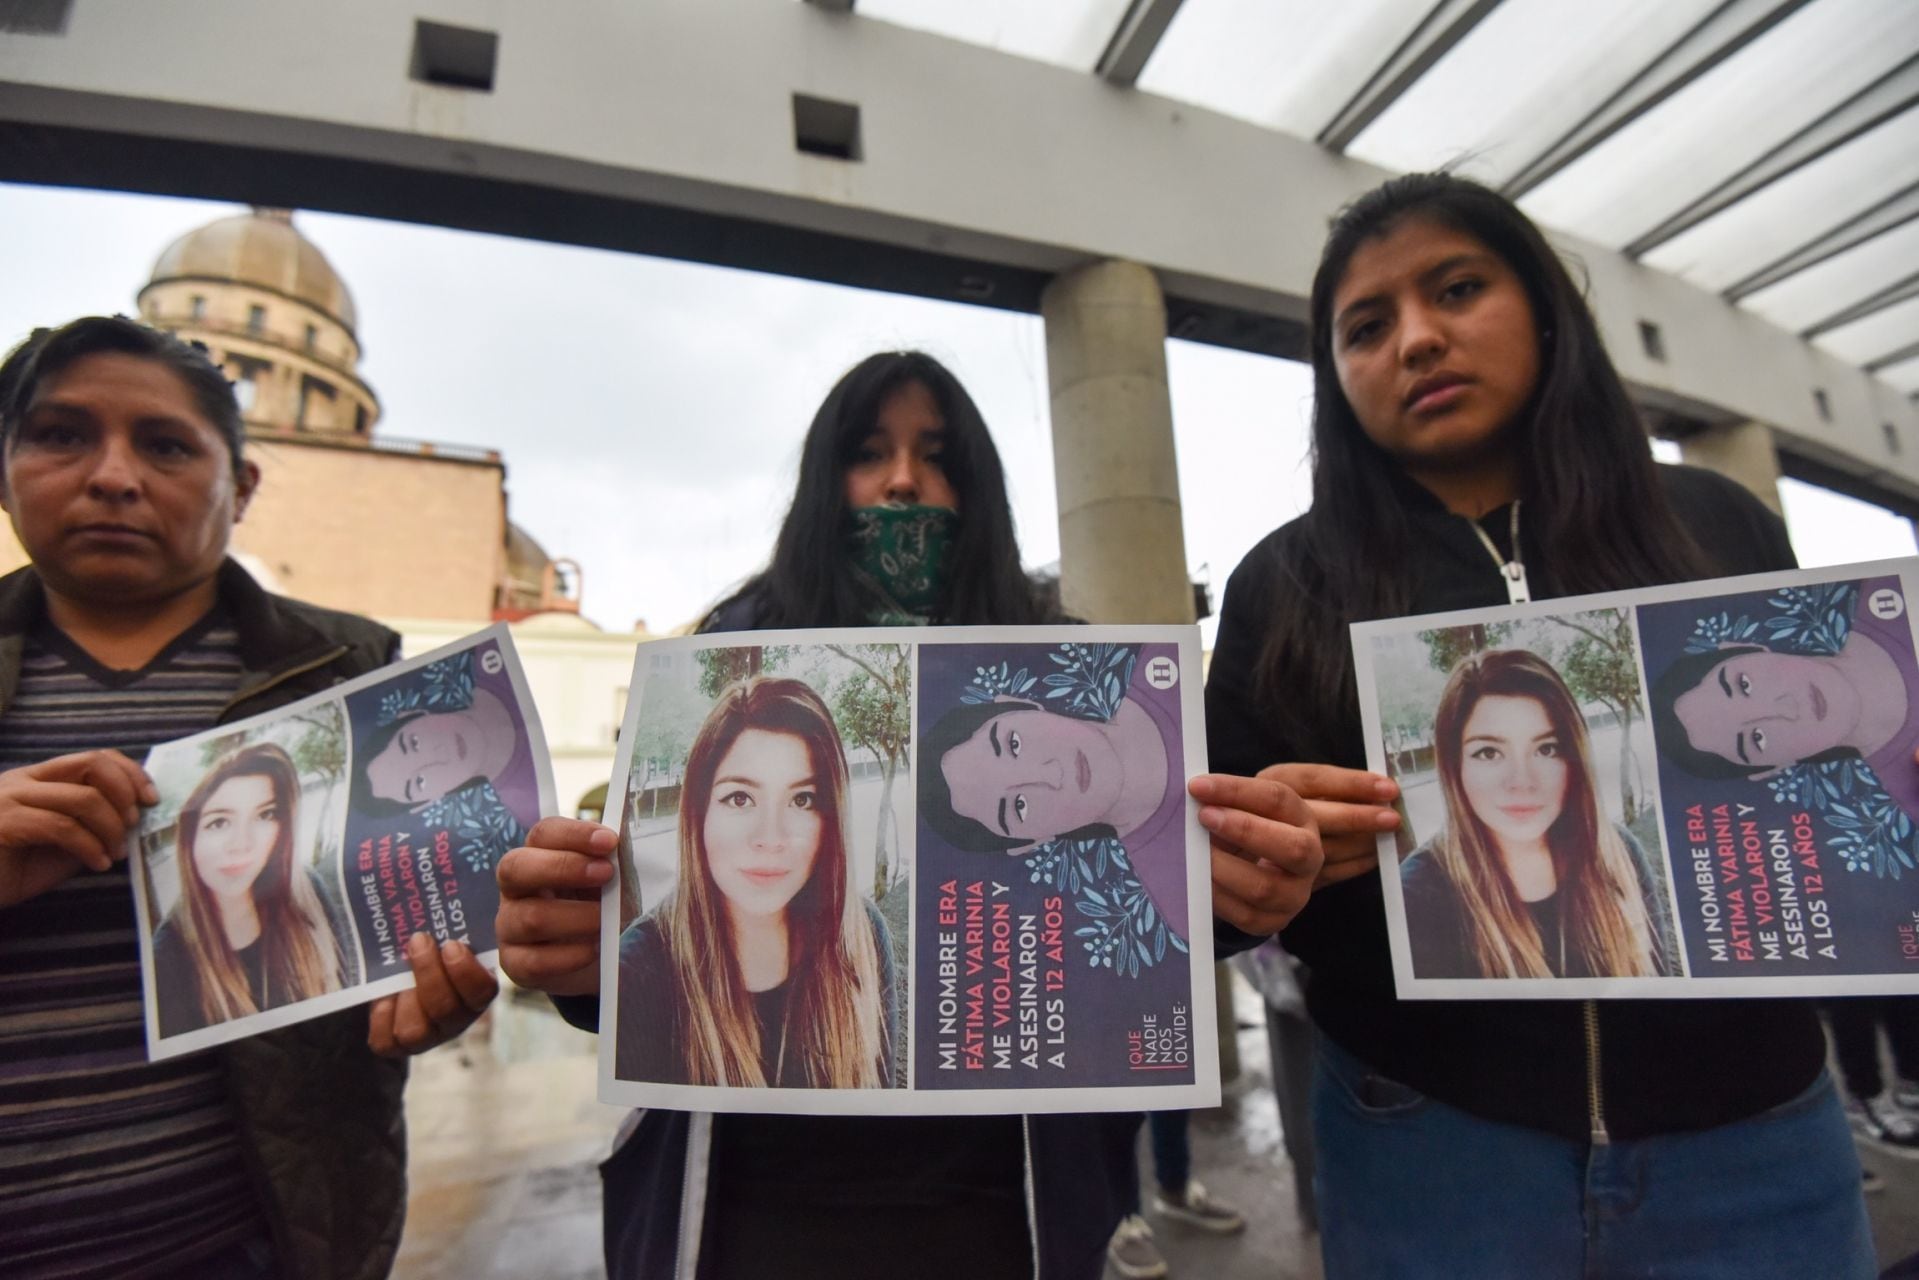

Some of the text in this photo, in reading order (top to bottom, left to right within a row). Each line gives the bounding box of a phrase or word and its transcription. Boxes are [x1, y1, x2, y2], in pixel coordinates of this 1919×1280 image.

[359, 838, 396, 966] MI NOMBRE ERA
[378, 834, 397, 900] VARINIA
[396, 832, 426, 929] VIOLARON Y
[444, 879, 458, 896] 12
[448, 899, 466, 931] LOS
[1685, 804, 1729, 961] MI NOMBRE ERA
[1712, 804, 1755, 961] FÁTIMA VARINIA
[1736, 803, 1782, 960] ME VIOLARON Y
[1768, 829, 1809, 960] ASESINARON
[1792, 812, 1837, 959] A LOS 12 AÑOS
[939, 880, 957, 1070] MI NOMBRE ERA
[961, 881, 984, 1070] FÁTIMA VARINIA
[992, 881, 1011, 1069] ME VIOLARON Y
[1019, 915, 1038, 1069] ASESINARON
[1041, 896, 1065, 1069] A LOS 12 AÑOS
[1143, 1014, 1158, 1063] NADIE
[1128, 1030, 1143, 1064] QUE
[1159, 1028, 1172, 1062] NOS
